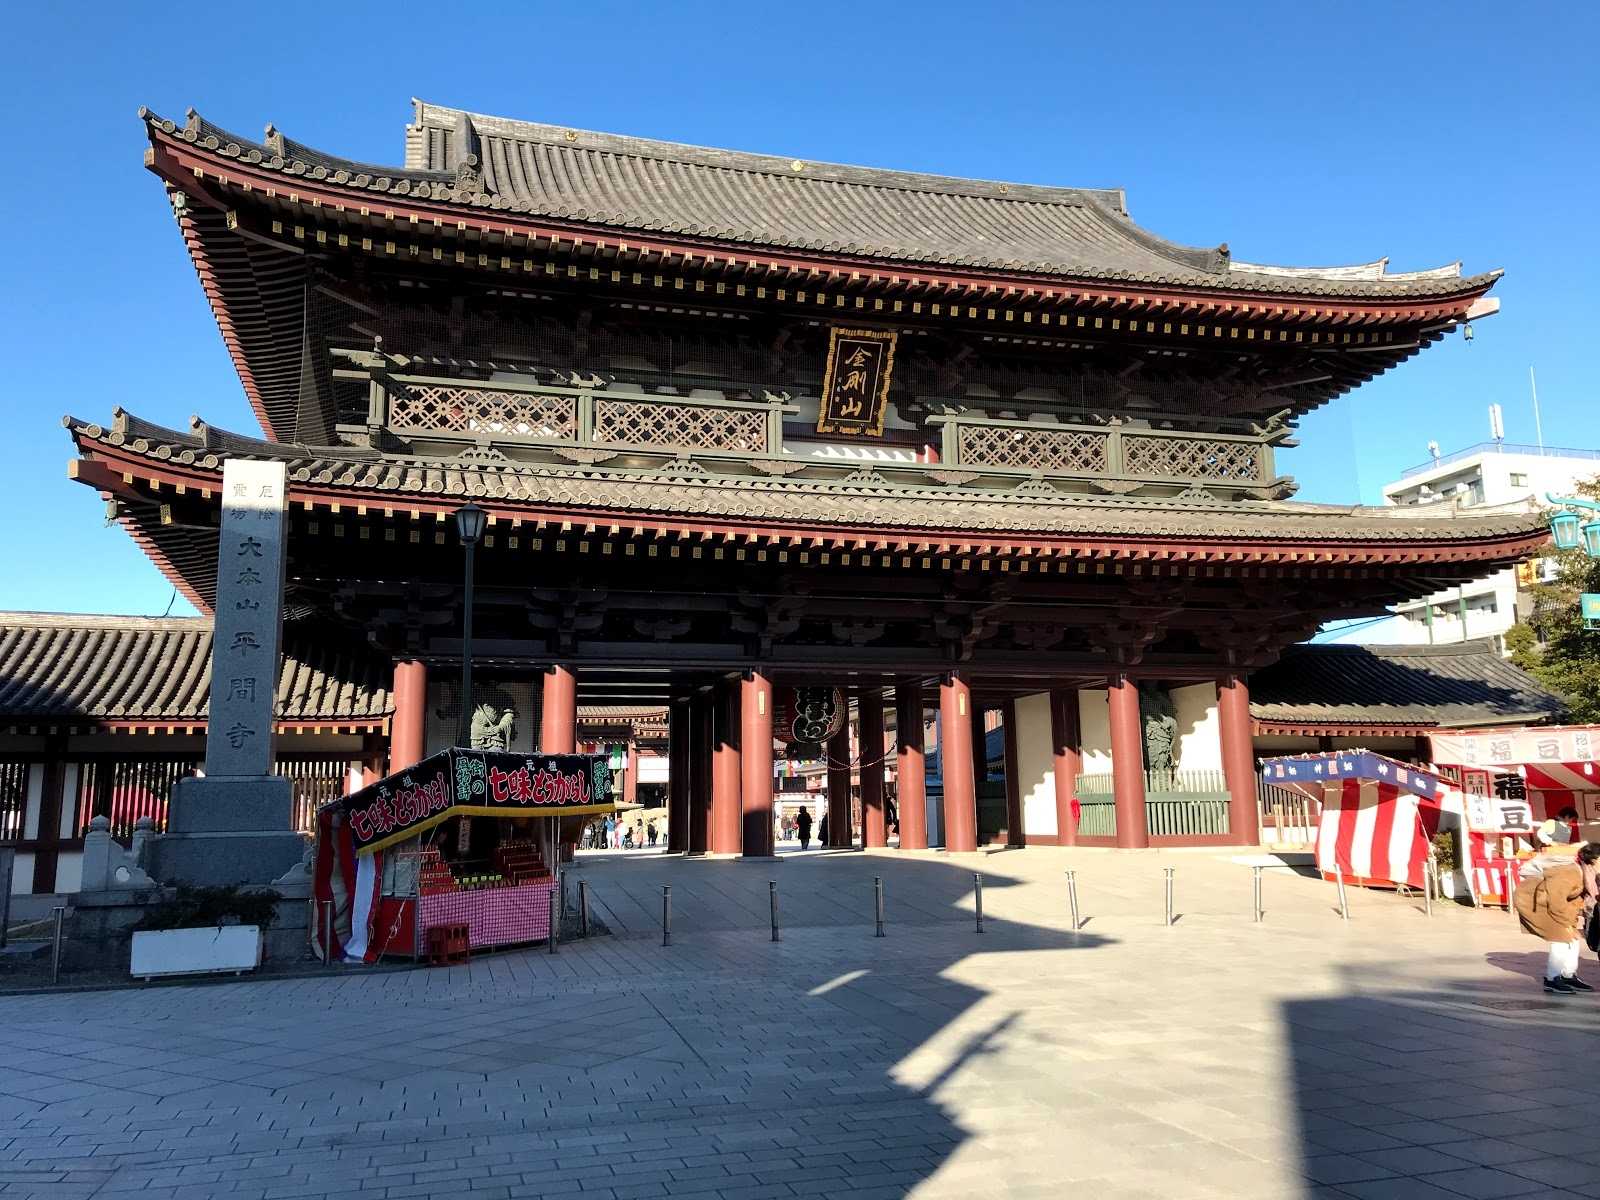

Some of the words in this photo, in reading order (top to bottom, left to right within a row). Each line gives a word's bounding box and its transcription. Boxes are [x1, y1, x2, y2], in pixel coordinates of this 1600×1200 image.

[226, 536, 262, 749] 大本山平間寺
[349, 771, 450, 842] 七味とうがらし
[489, 766, 591, 804] 七味とうがらし
[1494, 772, 1531, 832] 福豆
